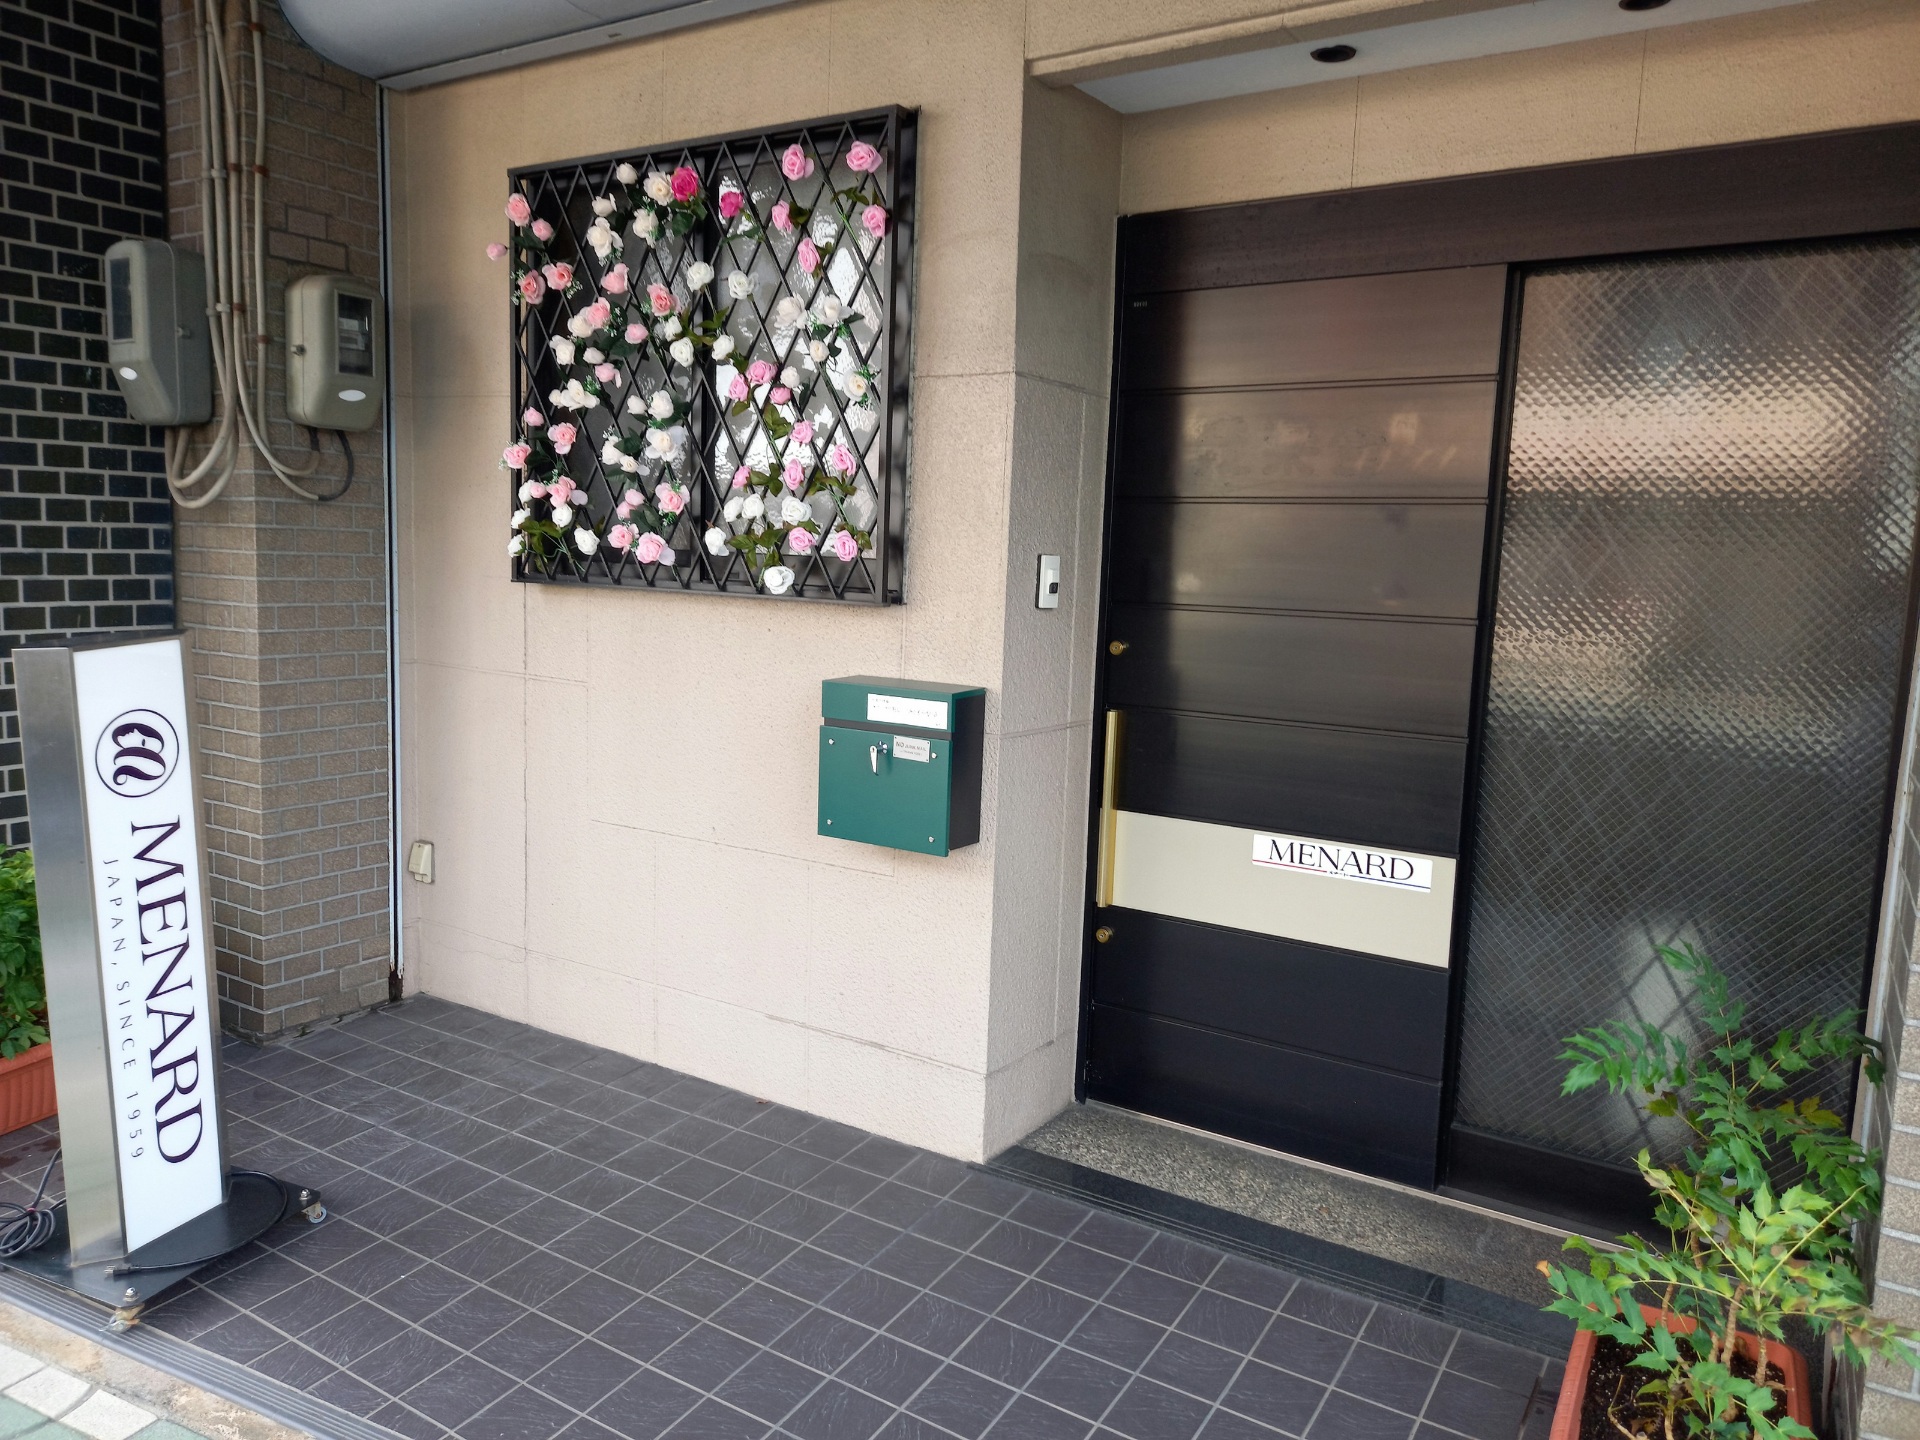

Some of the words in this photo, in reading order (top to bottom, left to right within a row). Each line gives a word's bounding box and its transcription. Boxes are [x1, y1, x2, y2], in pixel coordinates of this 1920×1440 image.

[1269, 839, 1414, 880] MENARD
[115, 981, 138, 1069] SINCE
[130, 816, 203, 1164] MENARD
[124, 1091, 146, 1160] 1959
